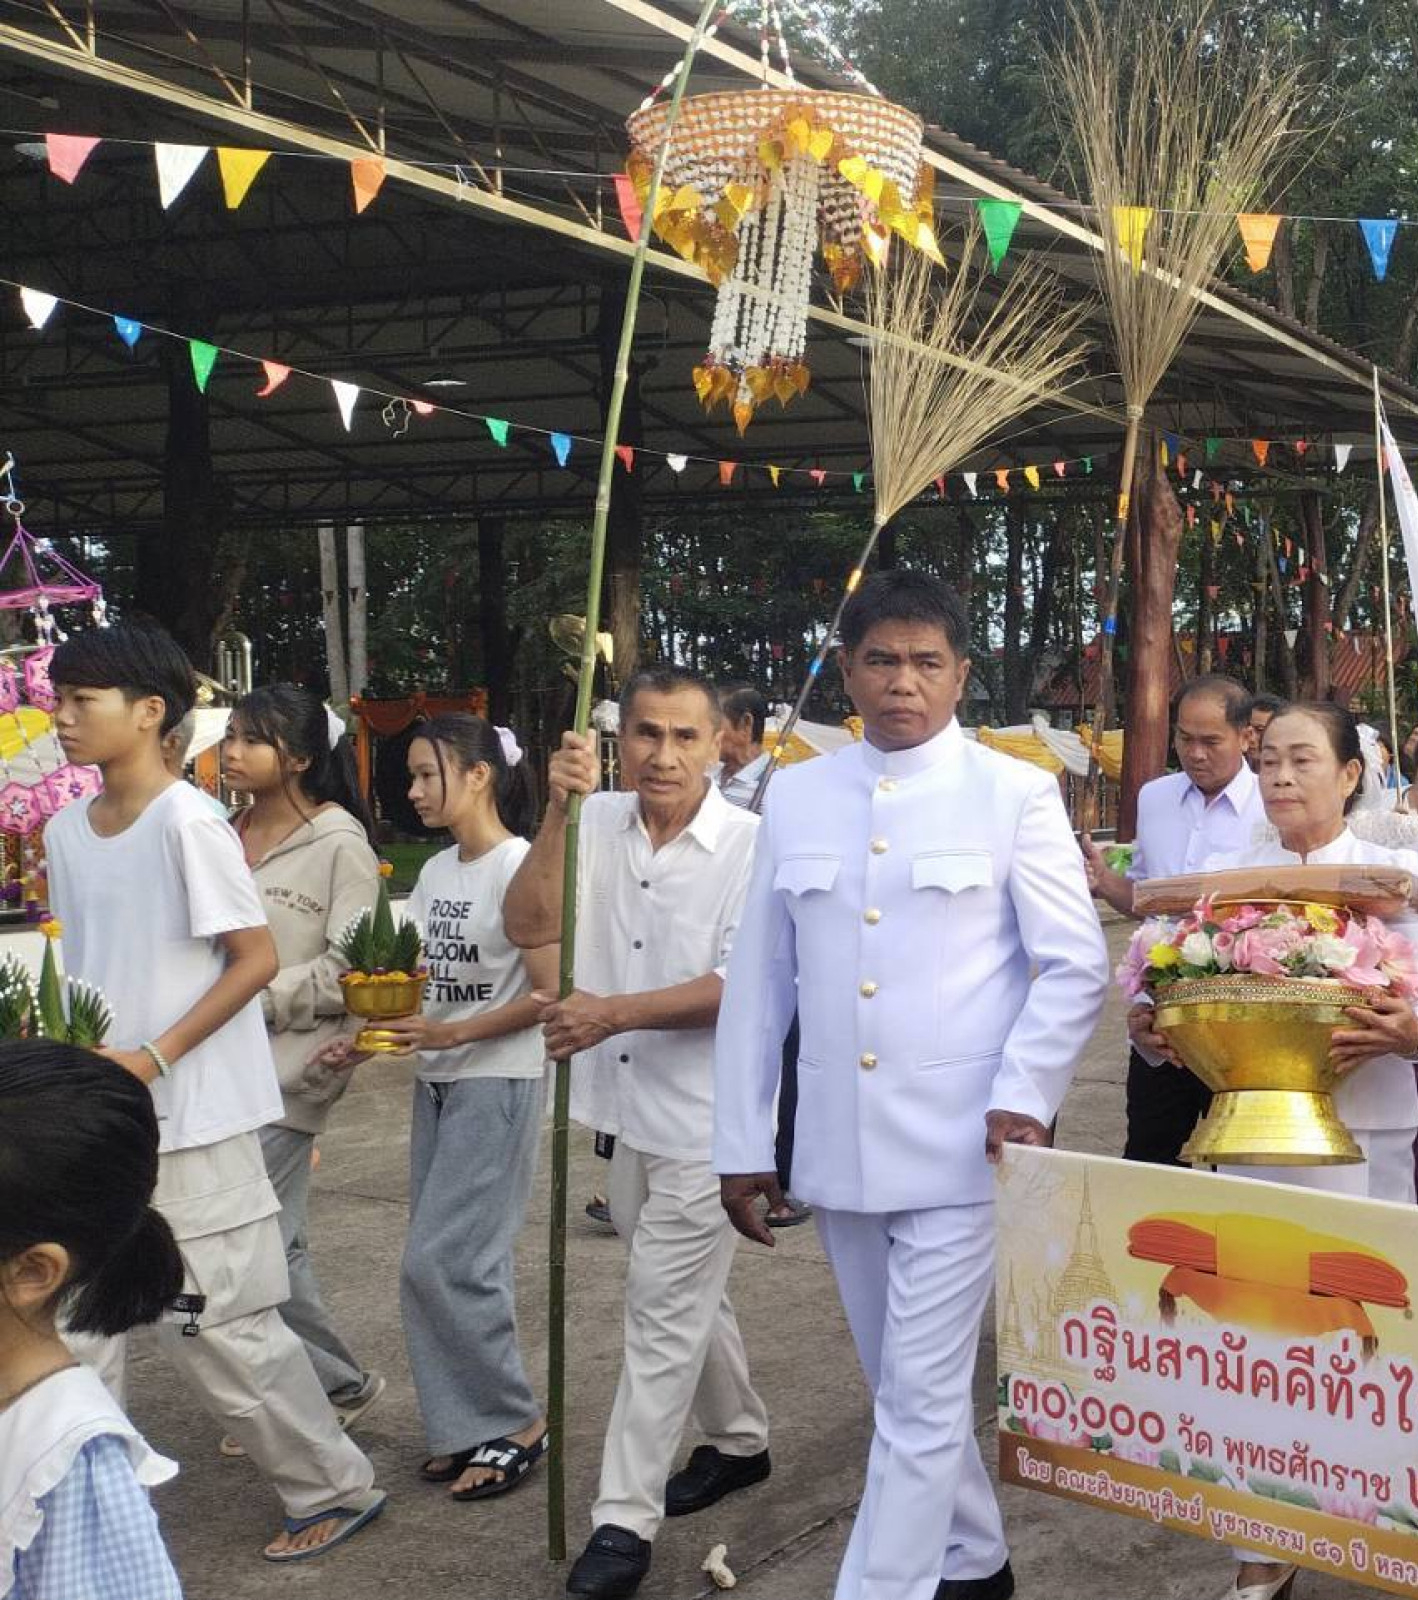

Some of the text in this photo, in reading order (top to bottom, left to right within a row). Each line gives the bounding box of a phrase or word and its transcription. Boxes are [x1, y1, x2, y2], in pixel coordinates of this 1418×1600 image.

[430, 899, 473, 919] ROSE
[428, 919, 465, 941] WILL
[435, 983, 493, 1002] TIME
[1013, 1378, 1166, 1445] ๓๐,๐๐๐
[1178, 1412, 1213, 1458] วัด
[1223, 1435, 1391, 1501] พุทธศักราช
[1018, 1448, 1050, 1481] โดย
[1056, 1469, 1202, 1521] คณะศิษยานุศิษย์
[1209, 1509, 1305, 1553] บูชาธรรม
[1351, 1539, 1366, 1569] ปี
